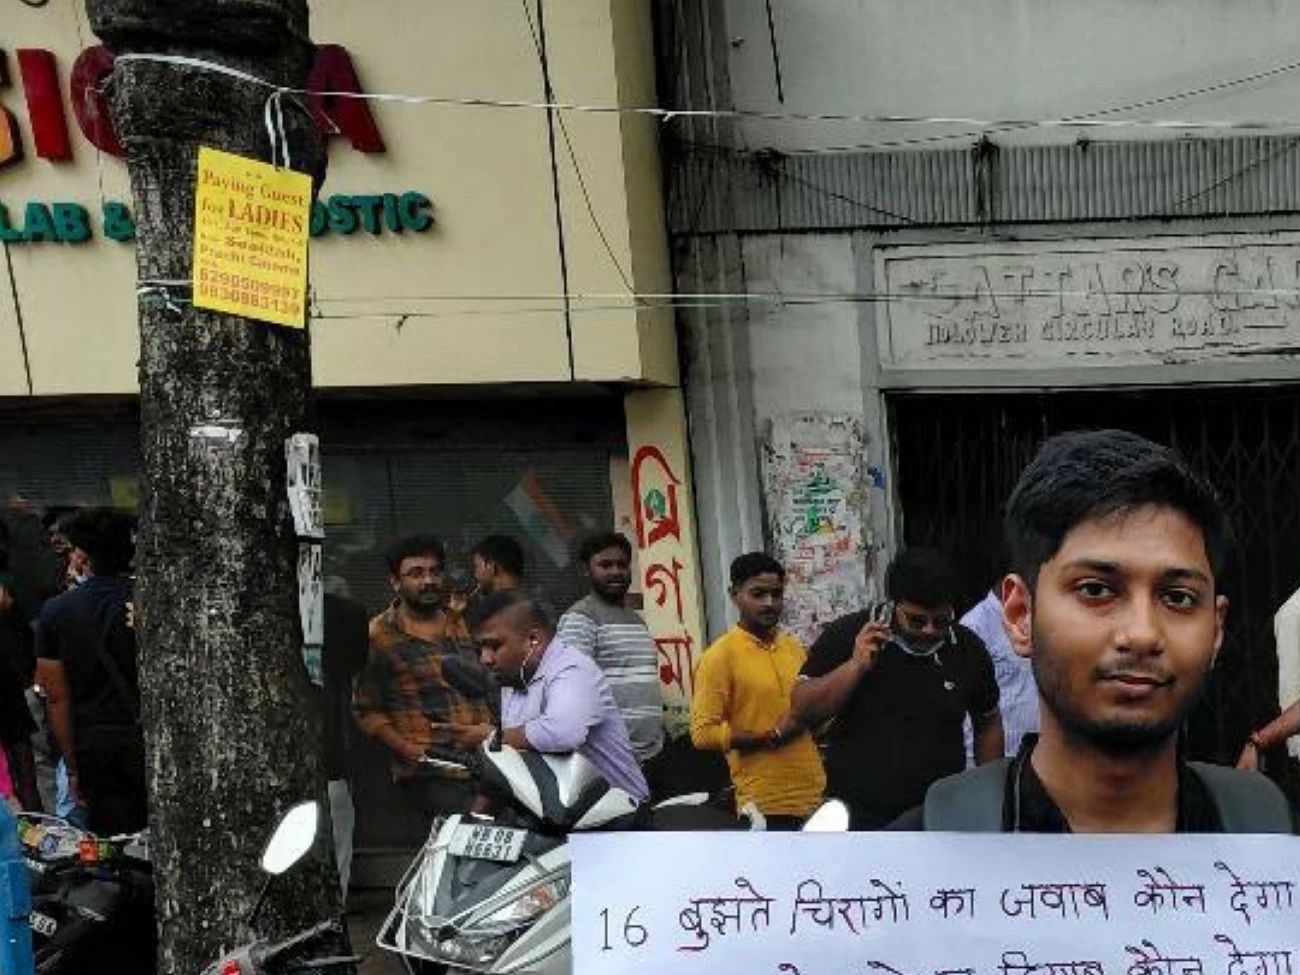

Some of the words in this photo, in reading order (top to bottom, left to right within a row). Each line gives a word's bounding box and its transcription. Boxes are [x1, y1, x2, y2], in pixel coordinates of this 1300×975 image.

[202, 169, 254, 198] Paying
[260, 183, 305, 207] Guest
[228, 197, 303, 233] LADIES
[599, 905, 648, 951] 16
[677, 876, 776, 952] बुझते
[929, 887, 976, 920] का
[1000, 883, 1110, 921] जवाब
[1133, 866, 1206, 923] कौन
[1213, 860, 1295, 926] देगा
